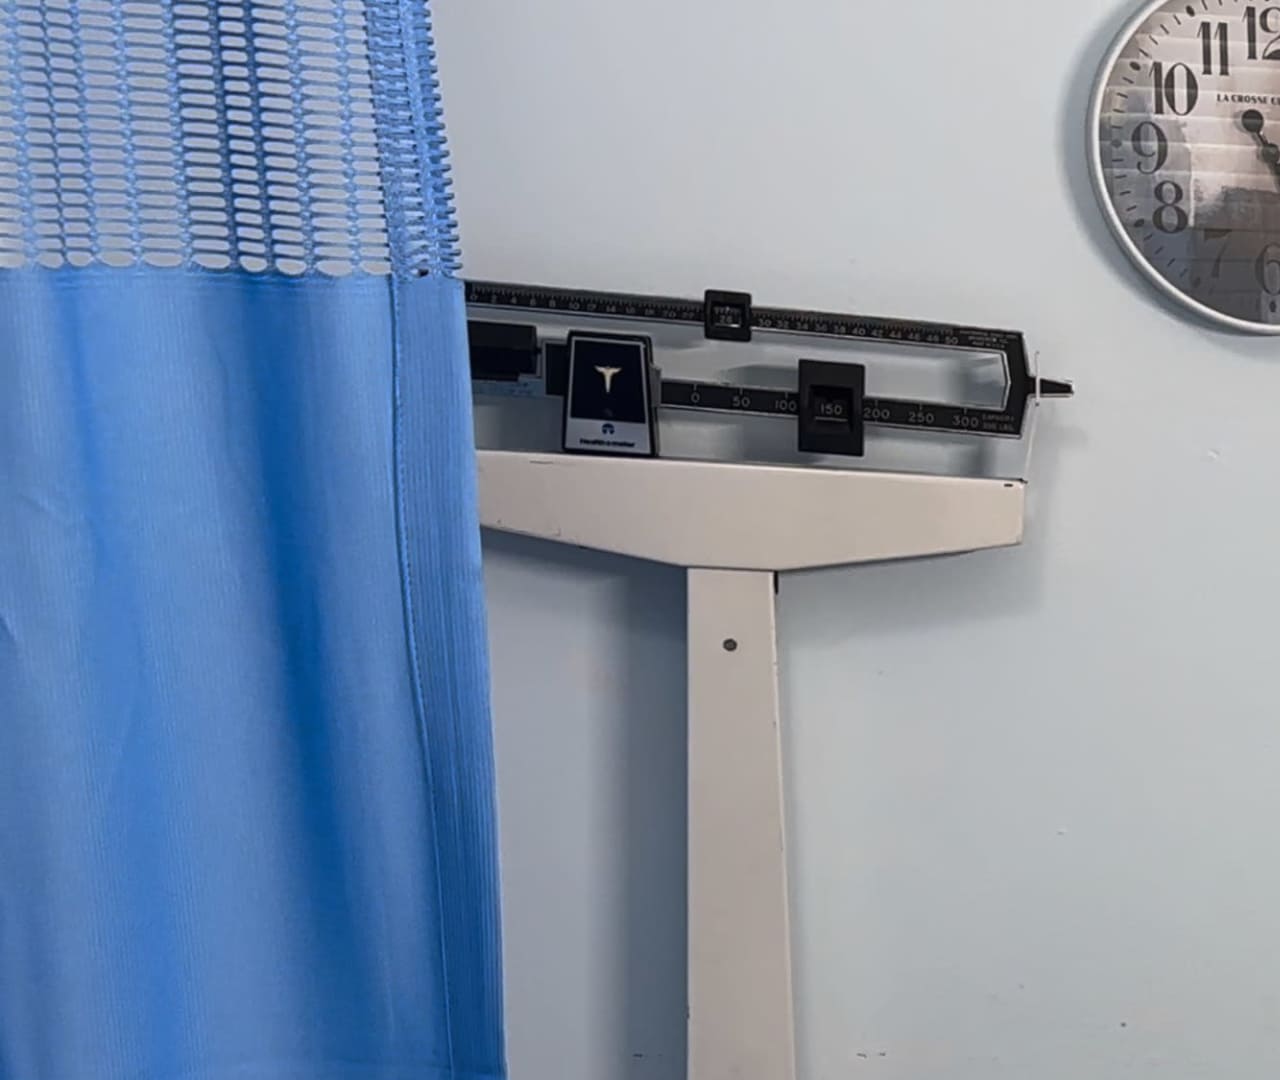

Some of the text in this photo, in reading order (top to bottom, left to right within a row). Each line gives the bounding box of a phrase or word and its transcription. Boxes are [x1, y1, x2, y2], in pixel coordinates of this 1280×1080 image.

[1198, 21, 1230, 76] 11
[1149, 61, 1199, 116] 10
[1216, 93, 1229, 103] LA
[1231, 94, 1268, 105] CROSSE
[1131, 121, 1169, 175] 9
[1152, 180, 1189, 234] 8
[1204, 228, 1233, 279] 7
[690, 391, 700, 404] 0
[733, 395, 751, 408] 50
[774, 399, 798, 412] 100
[820, 402, 843, 416] 150
[863, 407, 890, 419] 200
[908, 411, 935, 424] 250
[951, 415, 979, 428] 300
